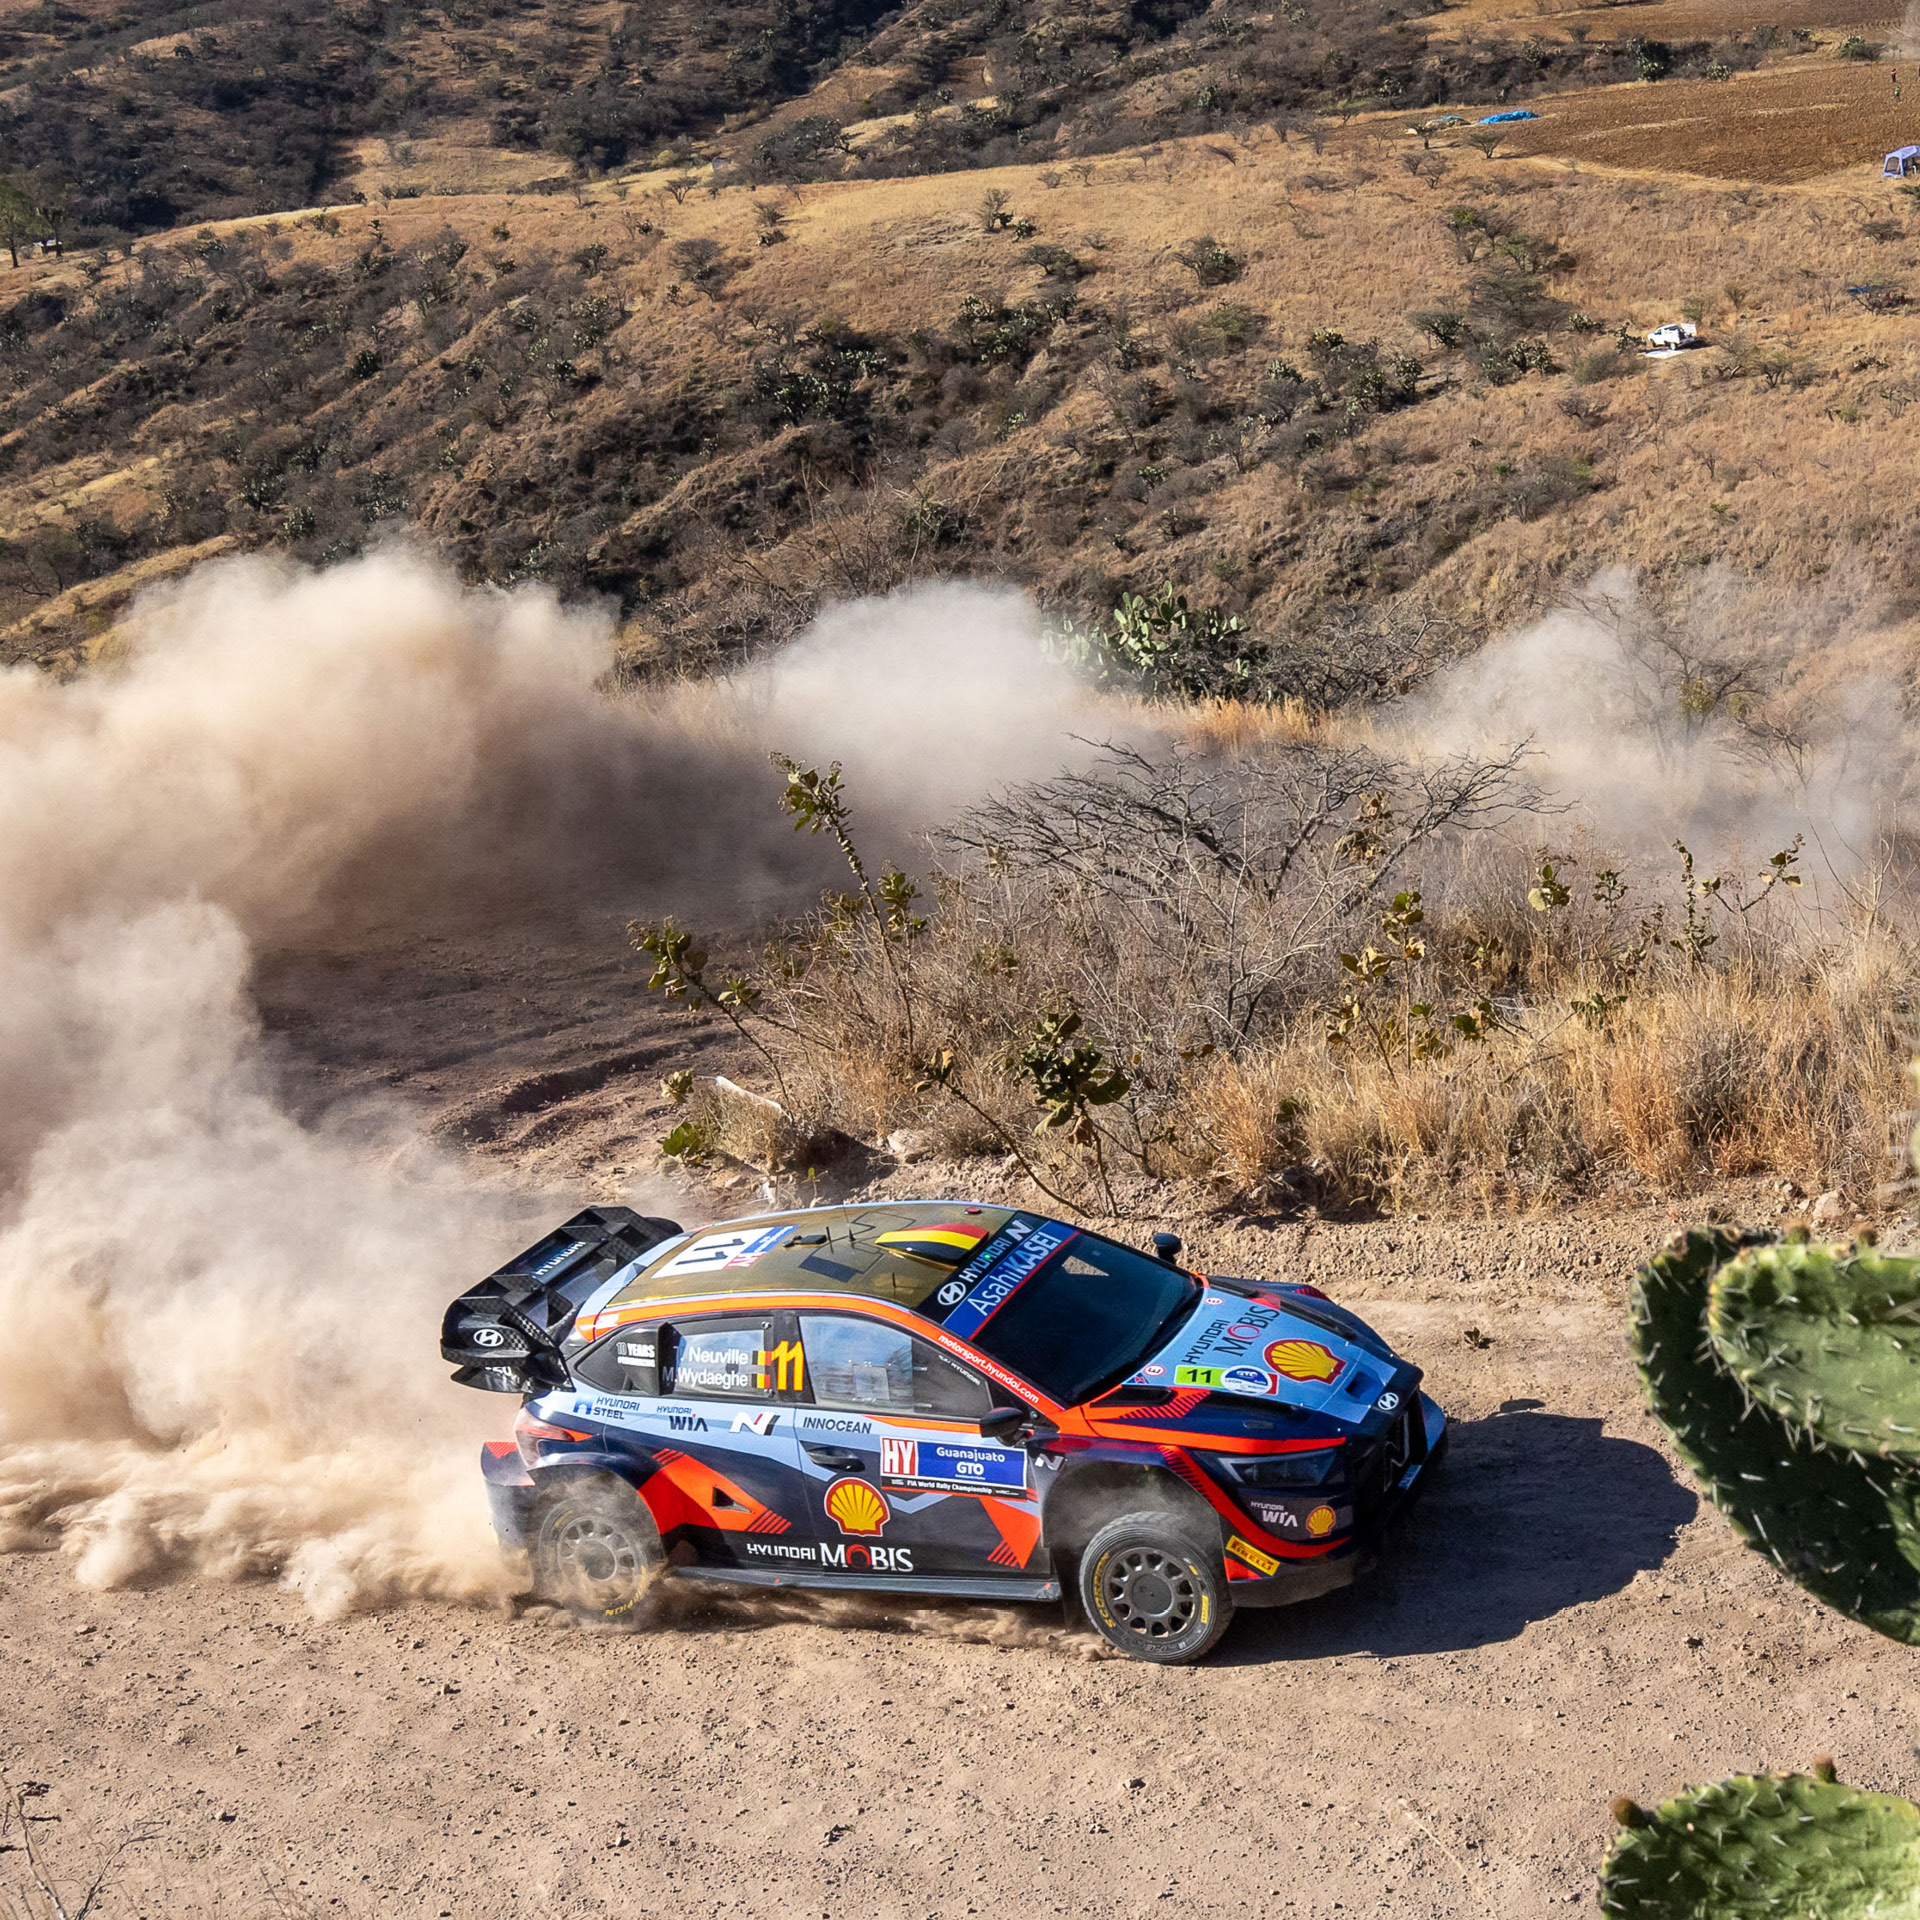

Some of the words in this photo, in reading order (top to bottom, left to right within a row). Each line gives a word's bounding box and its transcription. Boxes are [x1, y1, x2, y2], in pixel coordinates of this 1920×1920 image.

[958, 1237, 1013, 1283] HYUNDAI
[967, 1231, 1062, 1316] AsahiKASEI
[1213, 1305, 1281, 1358] MOBIS
[1182, 1319, 1231, 1364] HYUNDAI
[688, 1346, 749, 1365] Neuville
[771, 1340, 805, 1391] 11
[938, 1335, 1040, 1404] motorsport.hyundai.com
[1186, 1369, 1213, 1384] 11
[596, 1396, 640, 1411] HYUNDAI
[656, 1405, 692, 1414] HYUNDAI
[593, 1407, 625, 1420] STEEL
[668, 1414, 709, 1432] WIA
[803, 1417, 872, 1434] INNOCEAN
[882, 1437, 915, 1475] HY
[936, 1446, 1006, 1463] Guanajuato
[956, 1461, 985, 1476] GTO
[917, 1481, 935, 1489] World
[936, 1483, 951, 1491] Rally
[951, 1484, 993, 1495] Championship
[1250, 1501, 1285, 1511] HYUNDAI
[1262, 1509, 1298, 1527] WIA
[746, 1543, 817, 1561] HYUNDAI
[818, 1542, 914, 1573] MOBIS
[1230, 1540, 1275, 1571] PIRELLI
